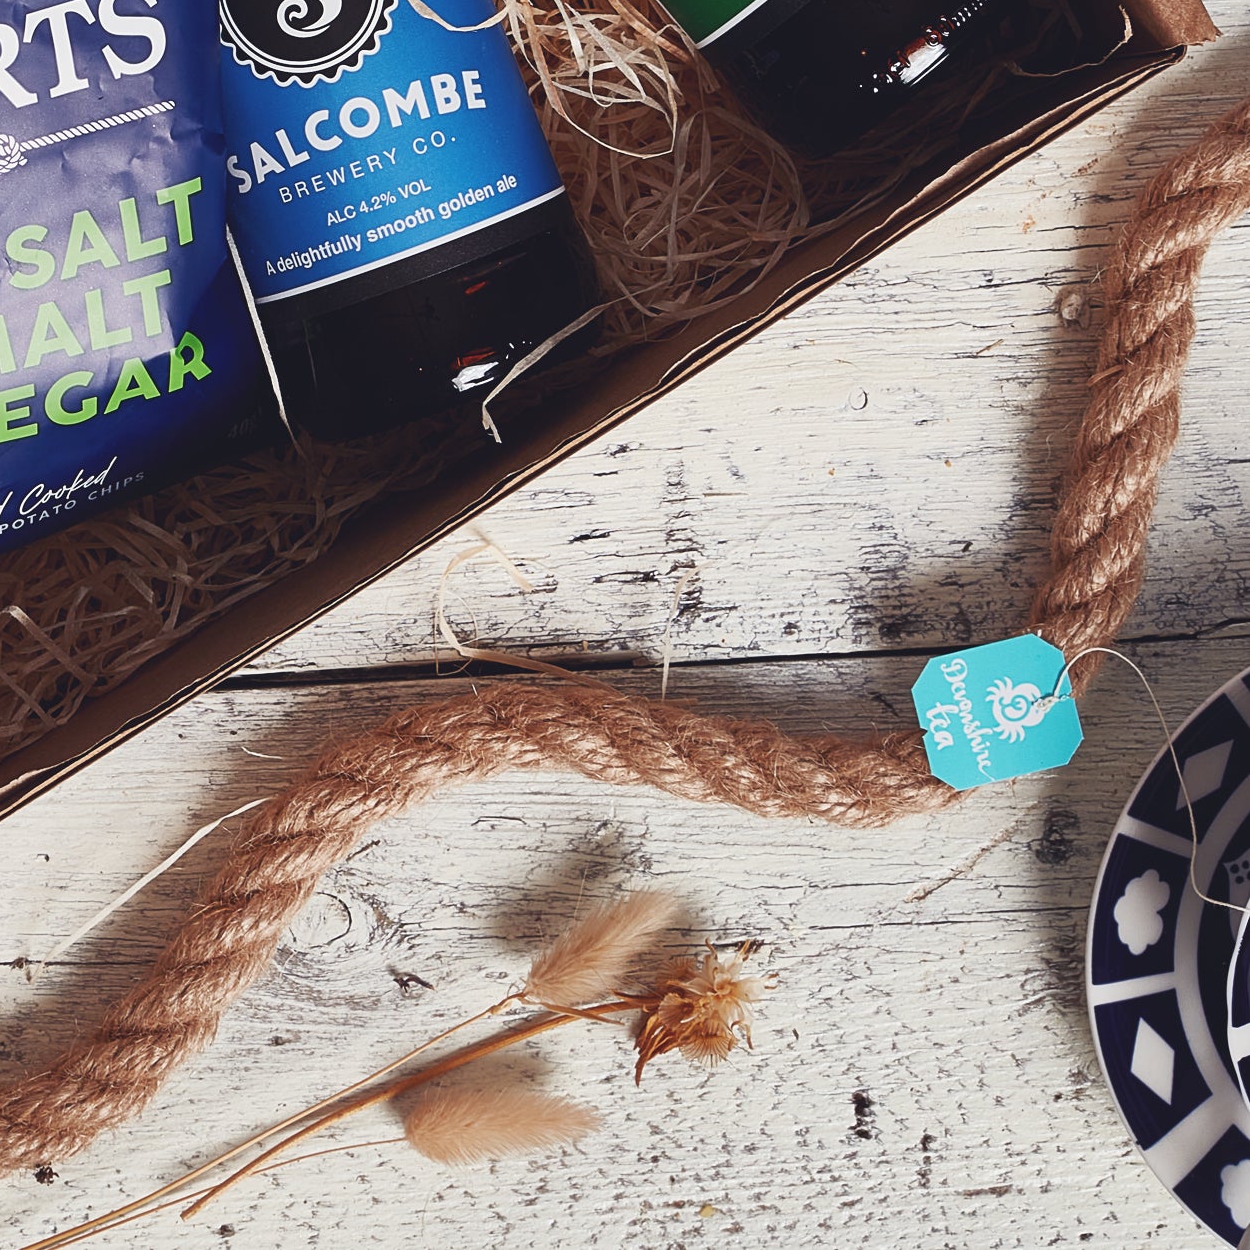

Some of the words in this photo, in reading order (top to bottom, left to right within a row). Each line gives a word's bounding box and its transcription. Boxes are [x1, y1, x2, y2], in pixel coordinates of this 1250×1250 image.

[227, 69, 487, 194] SALCOMBE
[279, 147, 398, 204] BREWERY
[412, 130, 457, 155] CO.
[4, 177, 202, 290] SALT
[266, 260, 277, 276] A
[276, 233, 363, 274] delightfully
[366, 204, 436, 243] smooth
[438, 183, 495, 220] golden
[496, 173, 518, 194] ale
[326, 204, 358, 227] ALC
[358, 191, 397, 215] 4.2%
[398, 178, 432, 200] VOL
[19, 455, 118, 516] Cooked
[87, 471, 145, 501] CHIPS
[925, 701, 960, 751] tea
[940, 657, 996, 782] Devonshire
